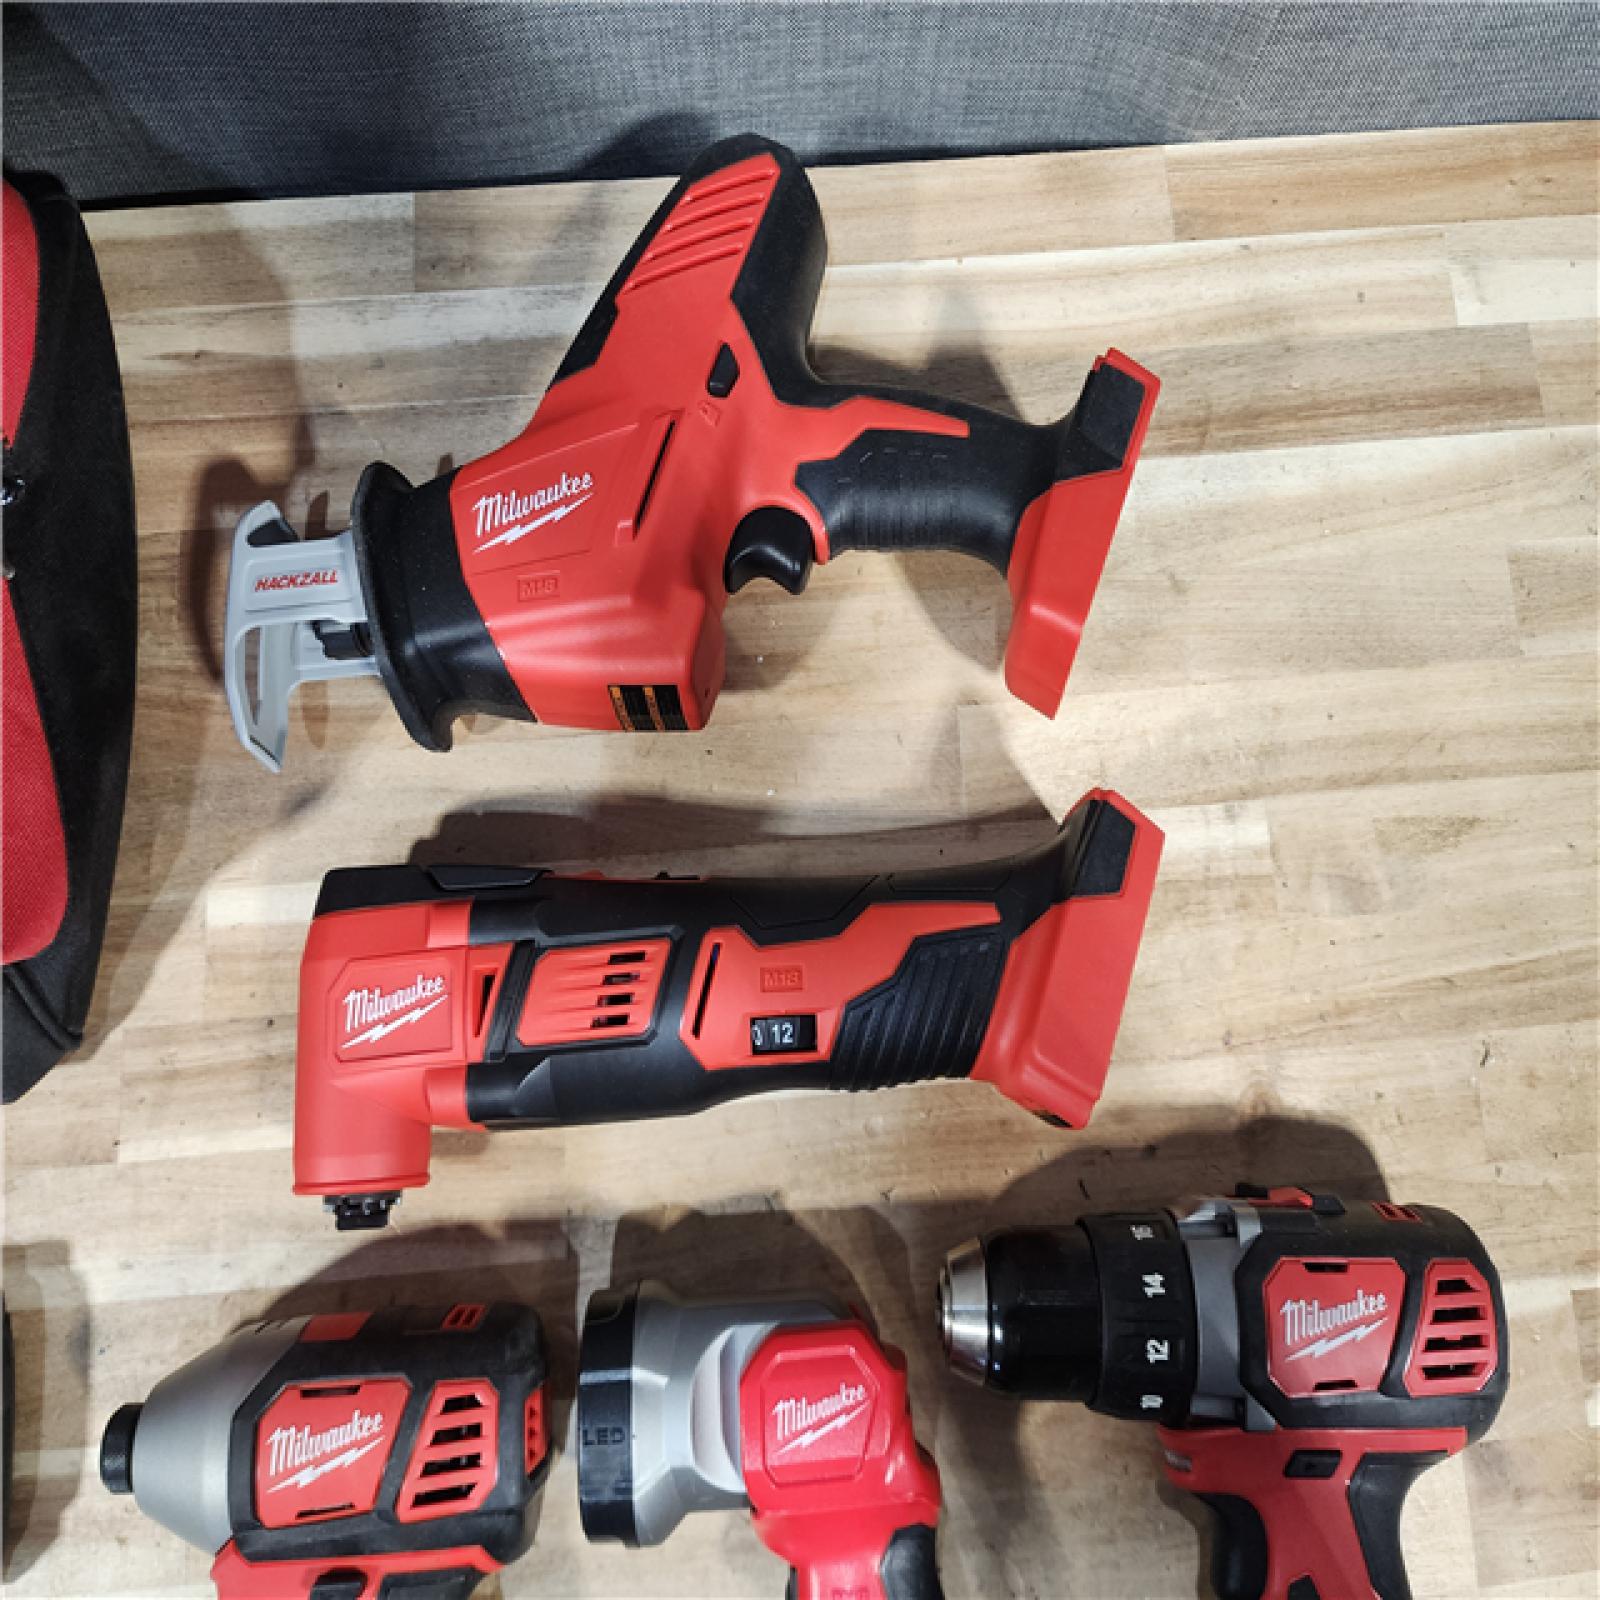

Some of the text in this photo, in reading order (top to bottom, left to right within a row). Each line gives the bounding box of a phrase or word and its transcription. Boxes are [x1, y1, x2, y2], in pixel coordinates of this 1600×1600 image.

[472, 471, 594, 538] Milwaukee
[255, 569, 338, 592] HACKZALL
[763, 969, 800, 988] M18
[343, 973, 445, 1033] Milwaukee
[771, 1022, 794, 1044] 12
[1142, 1272, 1166, 1298] 14
[1279, 1288, 1388, 1346] Milwaukee
[1146, 1339, 1169, 1364] 12
[772, 1381, 867, 1441] Milwaukee
[265, 1408, 384, 1476] Milwaukee
[582, 1426, 626, 1447] LED
